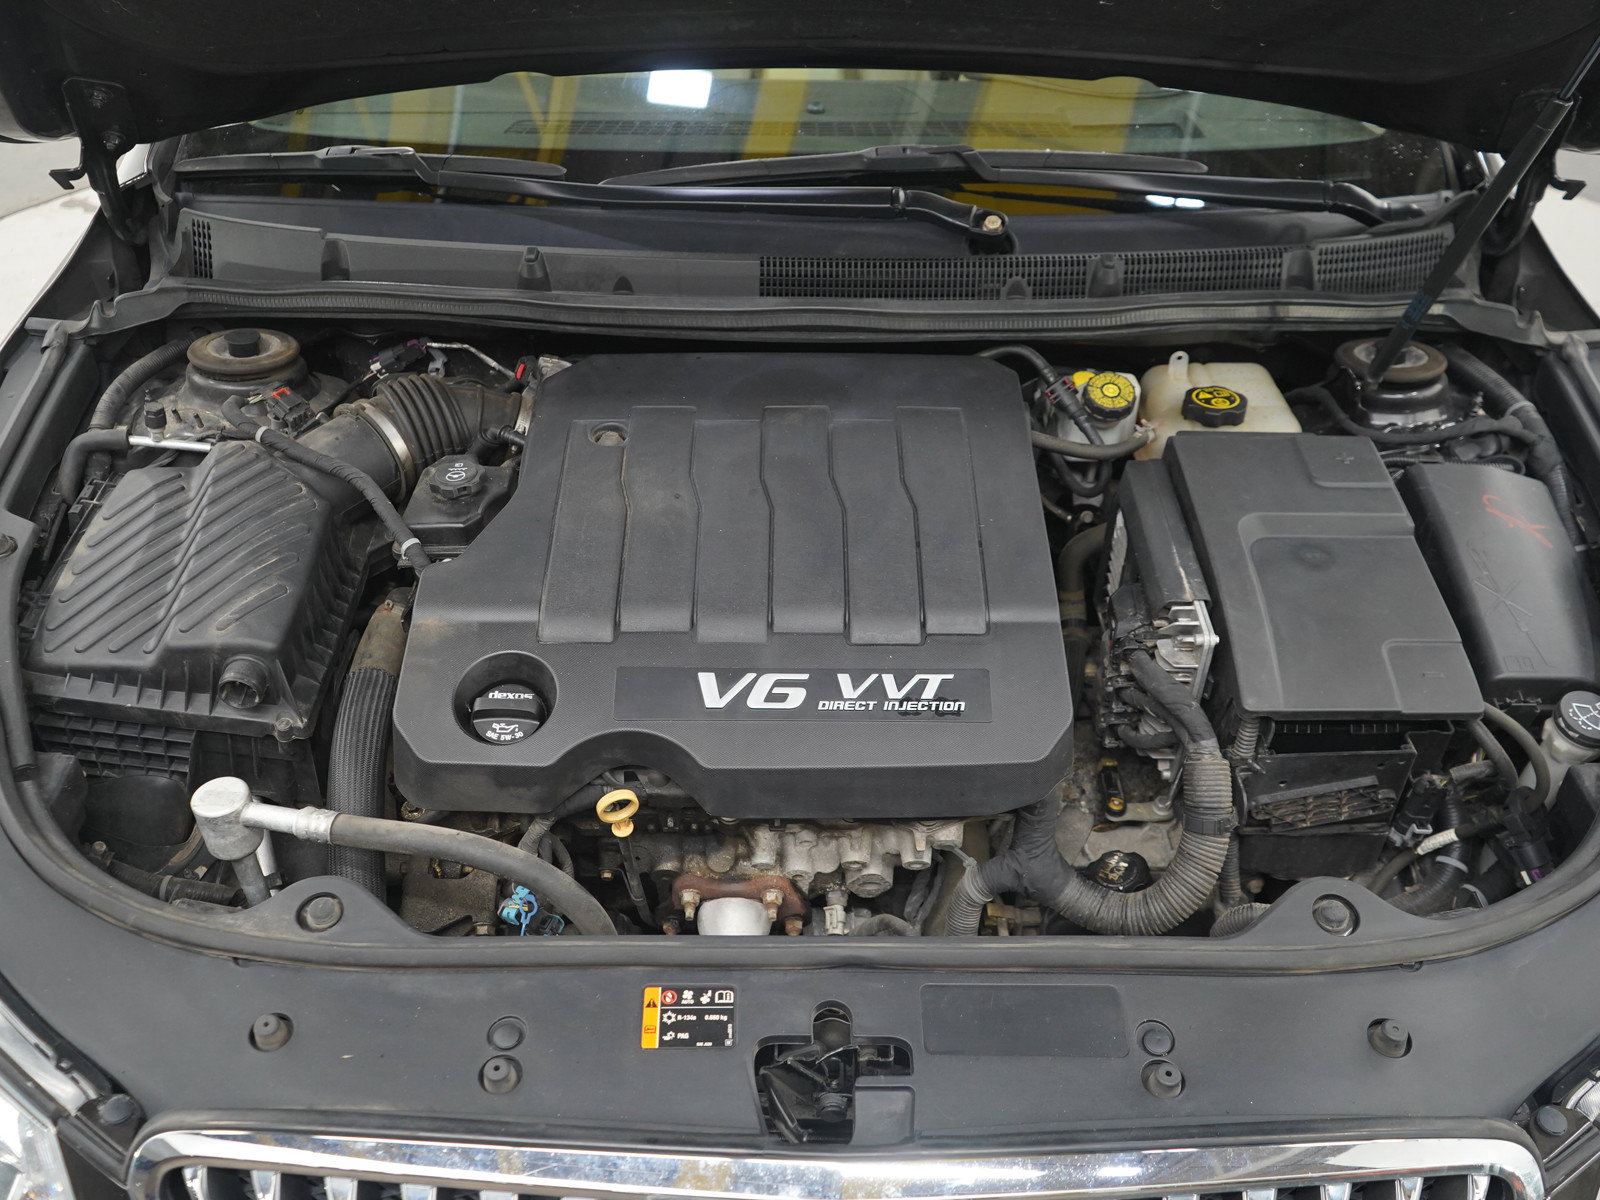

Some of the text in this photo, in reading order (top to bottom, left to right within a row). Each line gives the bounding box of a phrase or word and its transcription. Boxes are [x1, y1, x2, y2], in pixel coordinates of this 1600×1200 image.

[697, 672, 810, 710] V6
[836, 673, 955, 700] VVT
[488, 690, 534, 700] dexos
[817, 700, 966, 712] DIRECT INJECTION
[486, 730, 524, 740] SAE 5W-30
